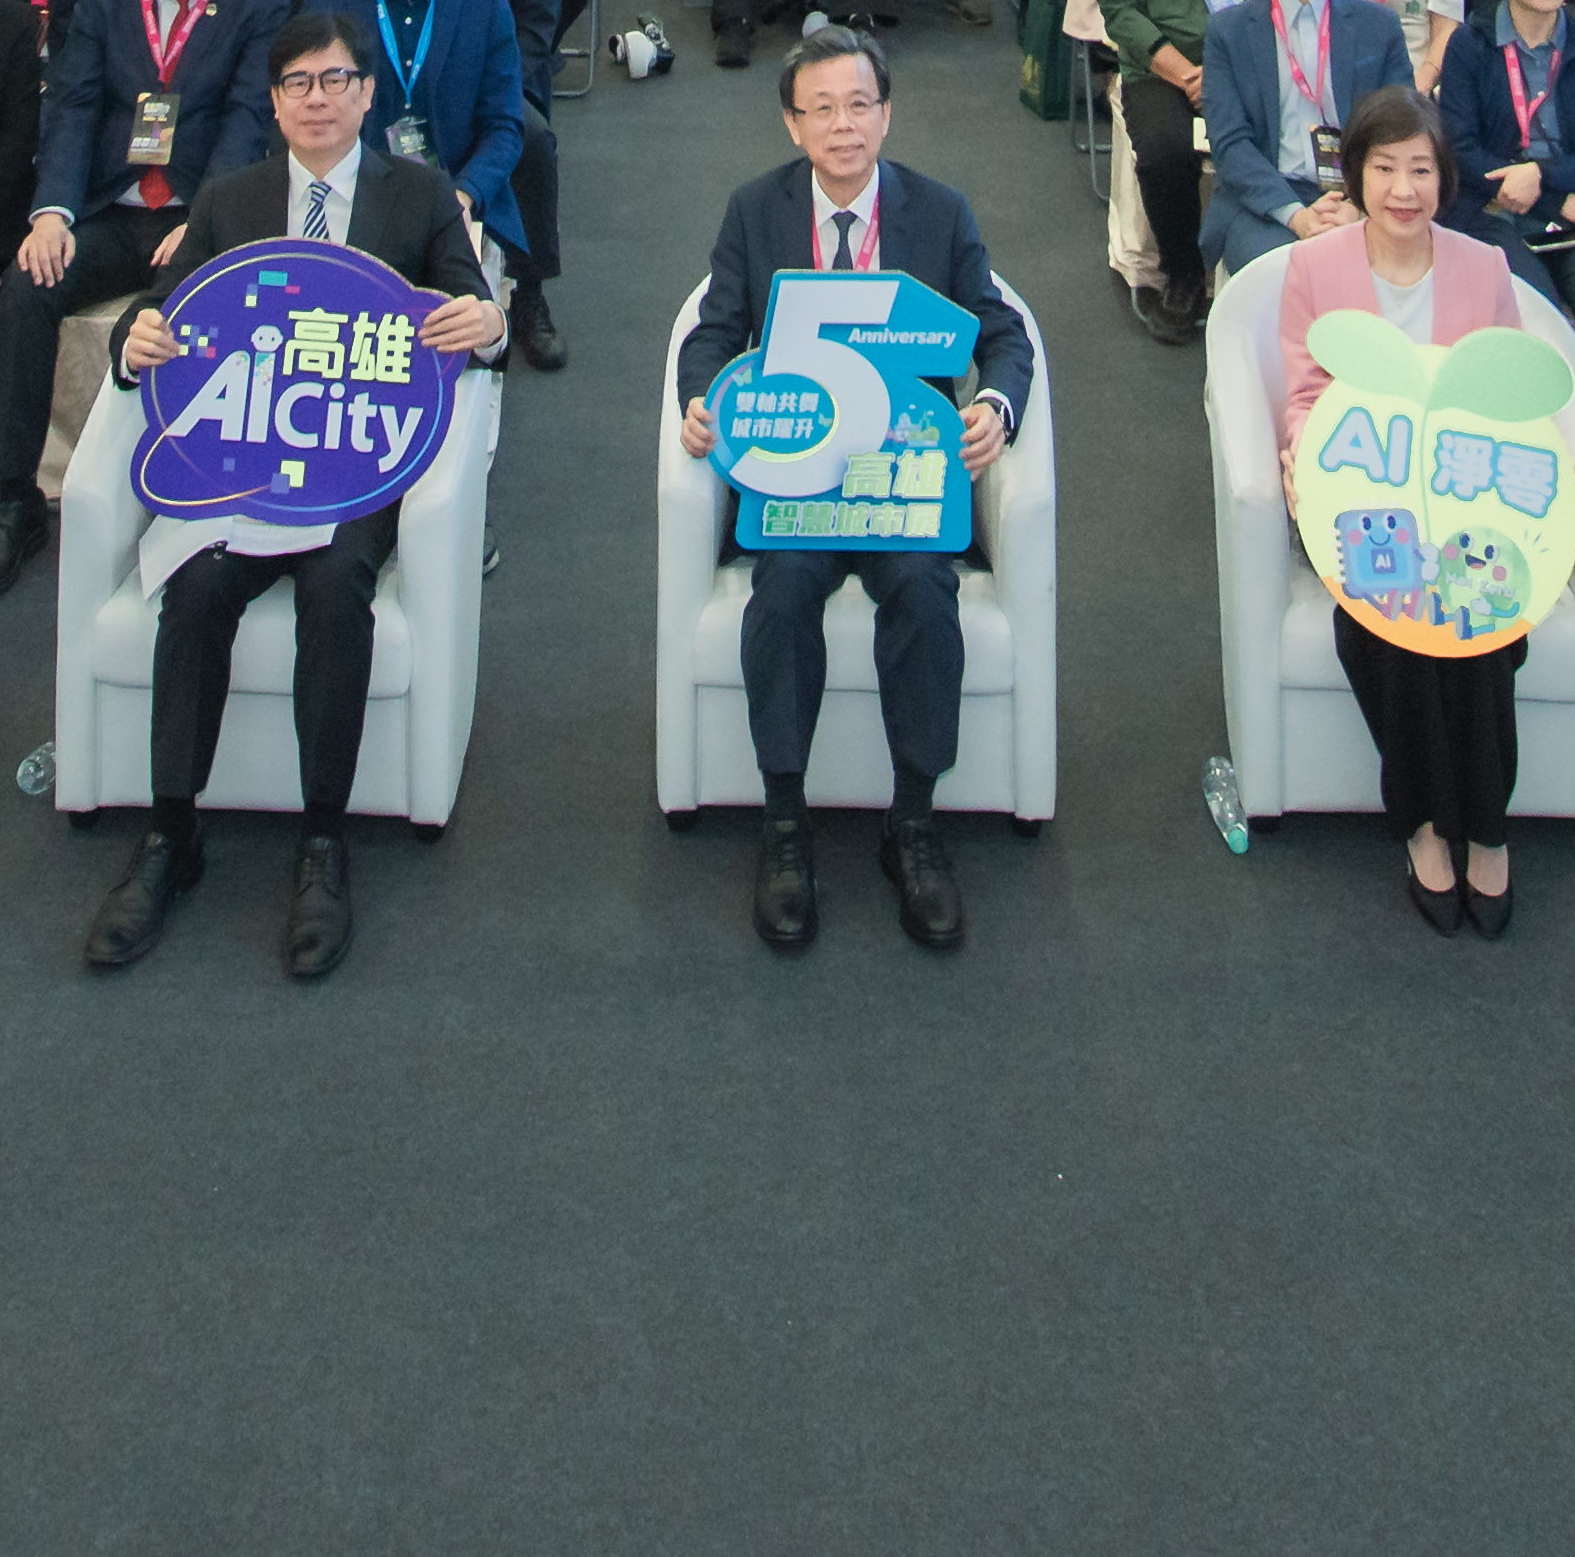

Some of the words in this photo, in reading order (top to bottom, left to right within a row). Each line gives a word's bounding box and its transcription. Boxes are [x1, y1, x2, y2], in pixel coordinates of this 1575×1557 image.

[282, 306, 416, 384] 高雄
[847, 327, 957, 349] Anniversary
[729, 279, 901, 498] 5
[841, 448, 948, 499] 高雄
[1319, 406, 1414, 487] AI
[1431, 429, 1558, 519] 淨零
[762, 500, 942, 538] 智慧城市展
[1374, 553, 1393, 570] AI
